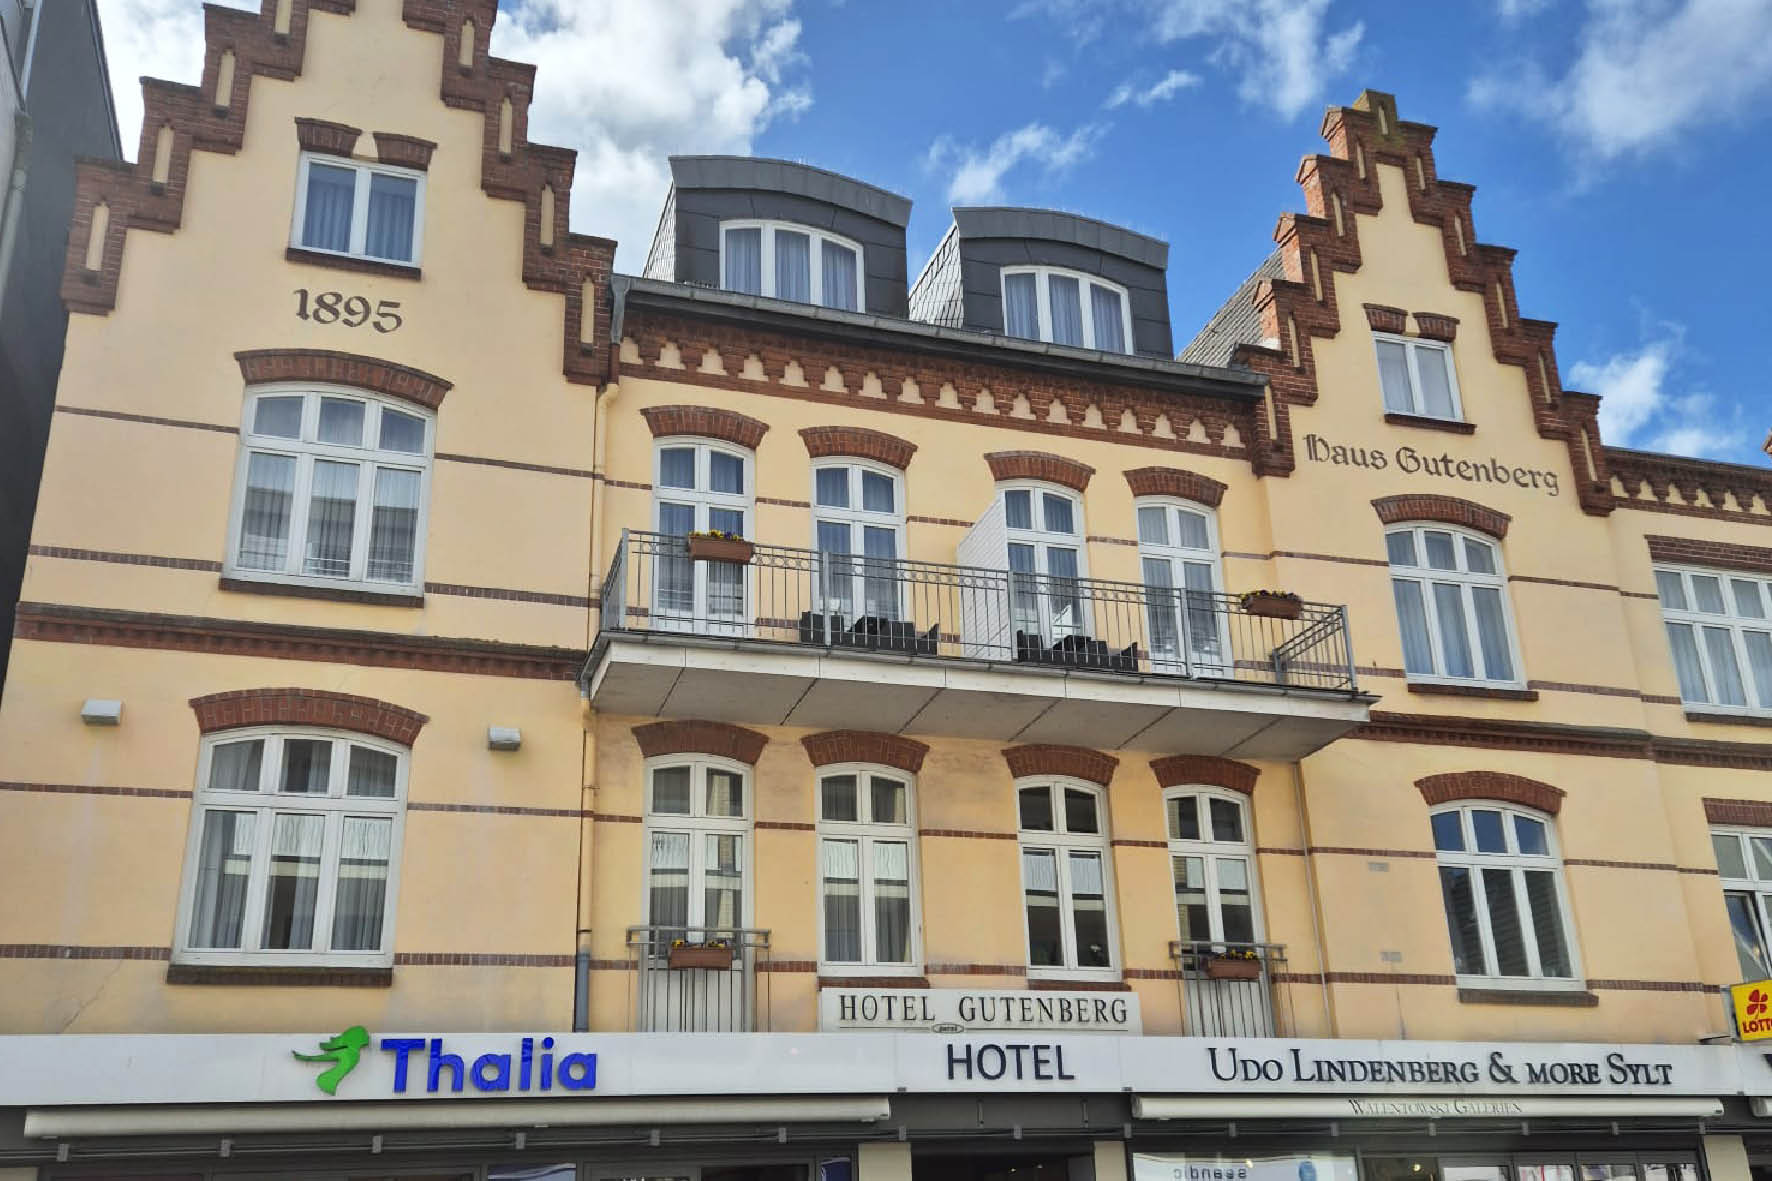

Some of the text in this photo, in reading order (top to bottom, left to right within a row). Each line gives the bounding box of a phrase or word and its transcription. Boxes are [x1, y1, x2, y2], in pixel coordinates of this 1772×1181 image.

[294, 288, 402, 333] 1895
[1303, 434, 1560, 496] Haus Gutenberg
[839, 994, 1128, 1024] HOTEL GUTENBERG
[381, 1036, 598, 1093] Thalia
[946, 1043, 1075, 1081] HOTEL
[1488, 1050, 1521, 1084] &
